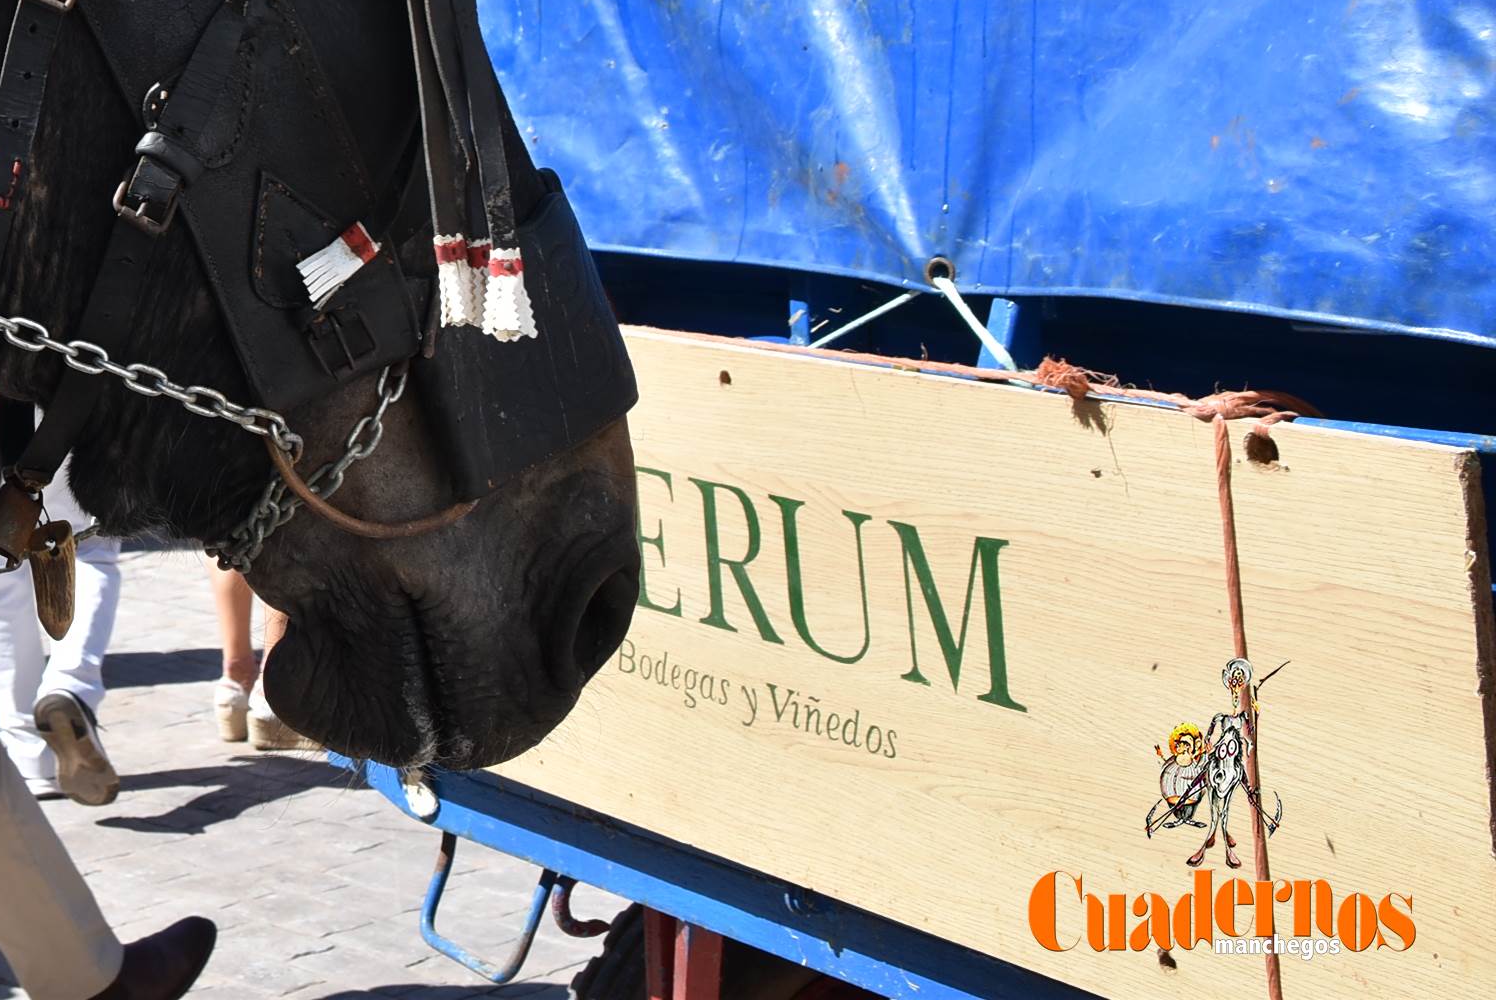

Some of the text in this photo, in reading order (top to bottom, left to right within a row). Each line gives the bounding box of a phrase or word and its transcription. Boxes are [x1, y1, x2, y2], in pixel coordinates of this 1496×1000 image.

[618, 638, 899, 759] Bodegas y Viñedos
